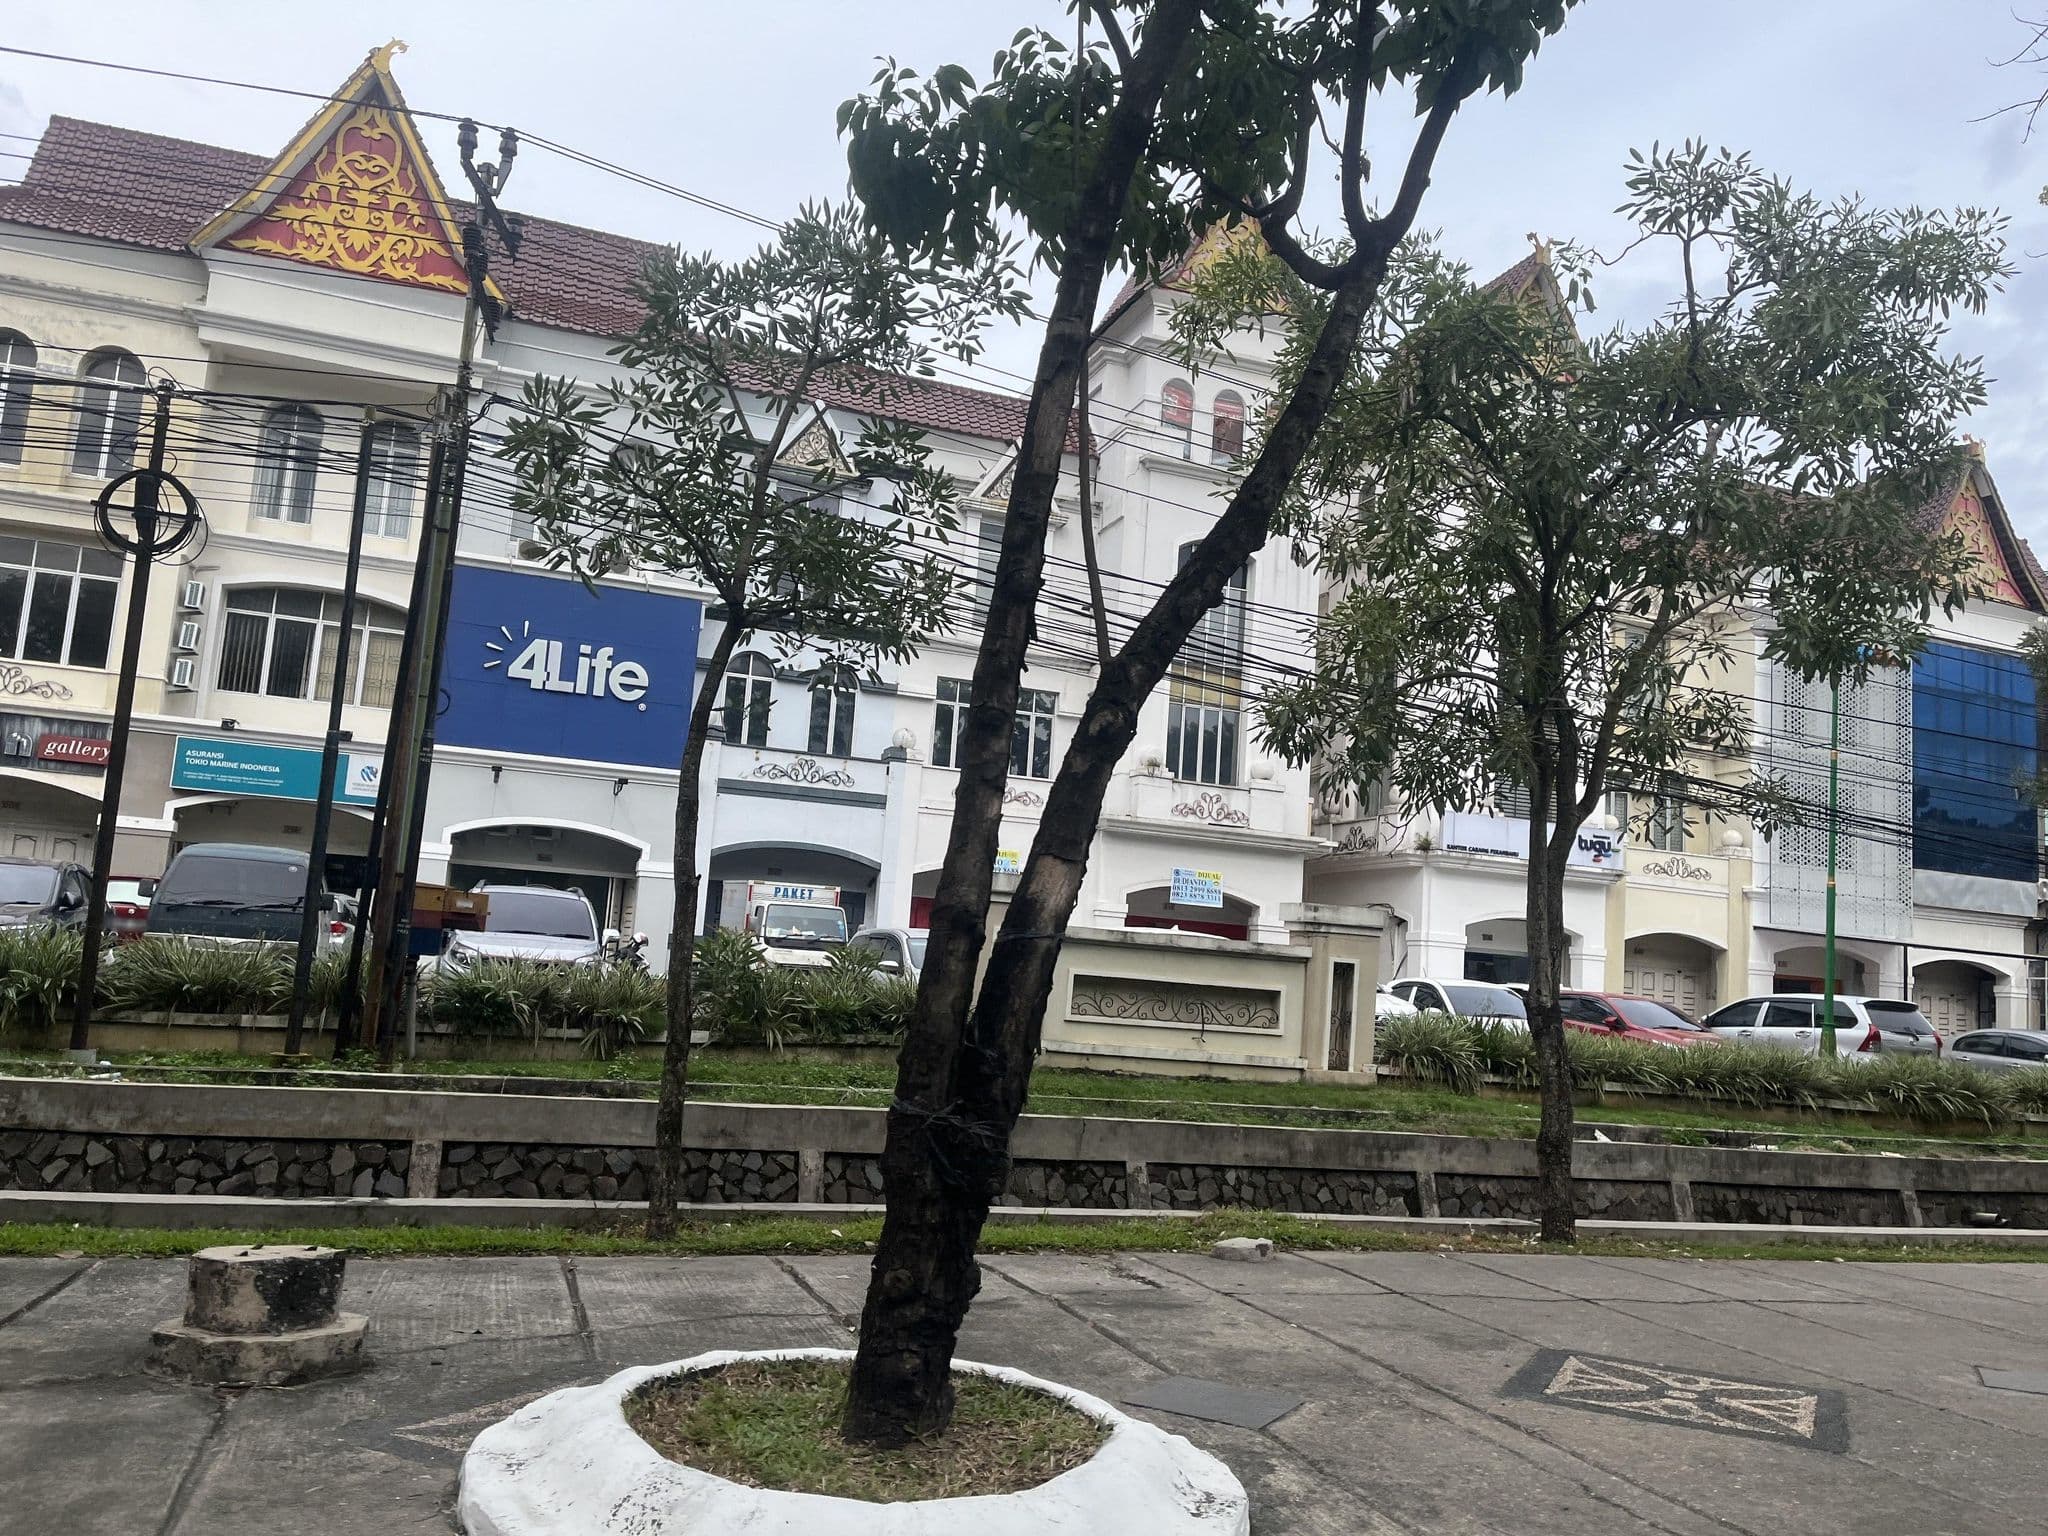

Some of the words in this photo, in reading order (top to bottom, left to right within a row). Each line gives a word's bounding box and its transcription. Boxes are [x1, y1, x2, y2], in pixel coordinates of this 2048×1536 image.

[508, 638, 649, 702] 4Life
[44, 740, 110, 761] gallery
[185, 749, 224, 760] ASURANSI
[185, 757, 209, 766] TOKIO
[209, 760, 239, 769] MARINE
[239, 762, 280, 773] INDONESIA
[1578, 834, 1612, 859] tugu
[774, 886, 815, 900] PAKET
